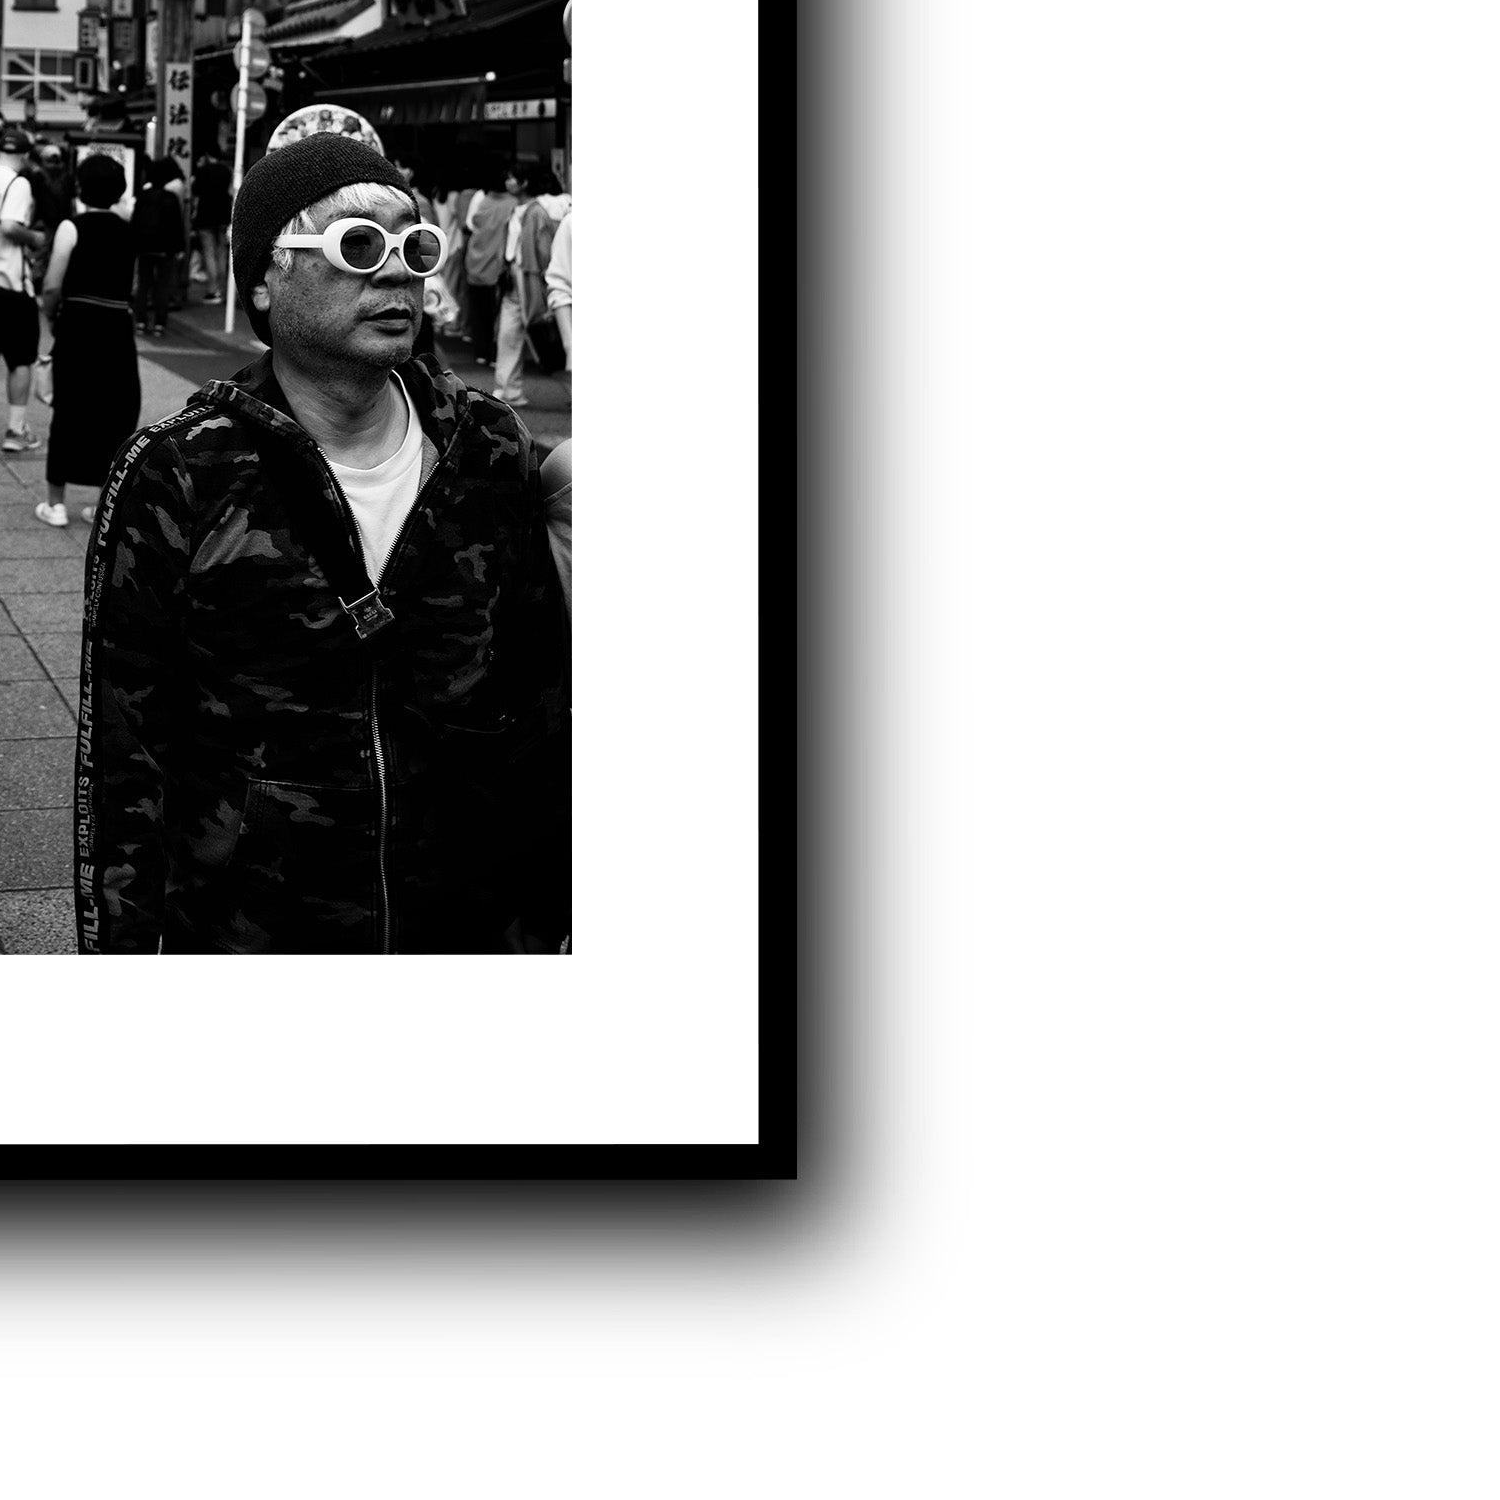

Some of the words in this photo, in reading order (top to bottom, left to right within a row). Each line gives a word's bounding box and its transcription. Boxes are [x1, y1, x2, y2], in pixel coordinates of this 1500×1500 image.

[168, 69, 190, 160] 伝法院
[97, 434, 151, 547] FULFILL-ME
[79, 638, 94, 769] FULFILL-ME
[77, 775, 91, 858] EXPLOITS
